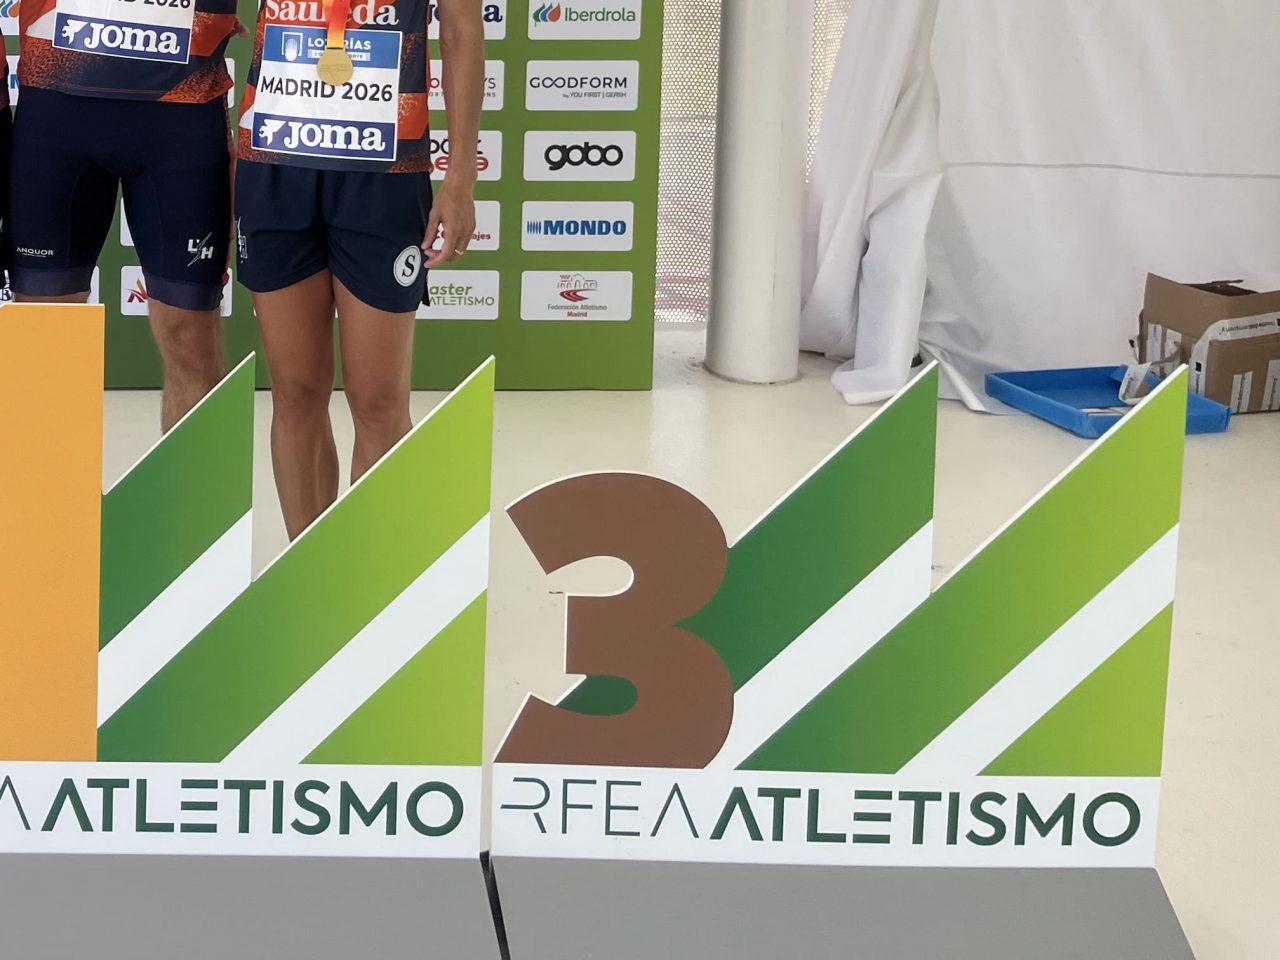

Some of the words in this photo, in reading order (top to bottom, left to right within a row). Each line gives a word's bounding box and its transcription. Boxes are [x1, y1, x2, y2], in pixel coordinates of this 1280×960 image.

[565, 6, 636, 22] Iberdrola
[260, 76, 335, 98] MADRID
[341, 83, 392, 102] 2026
[529, 76, 627, 89] GOODFORM
[544, 142, 624, 170] gobo
[544, 220, 627, 235] MONDO
[430, 283, 472, 295] aster
[493, 471, 734, 769] 3
[41, 777, 464, 837] ATLETISMO
[500, 777, 699, 838] RFEA
[709, 786, 1141, 847] ATLETISMO
